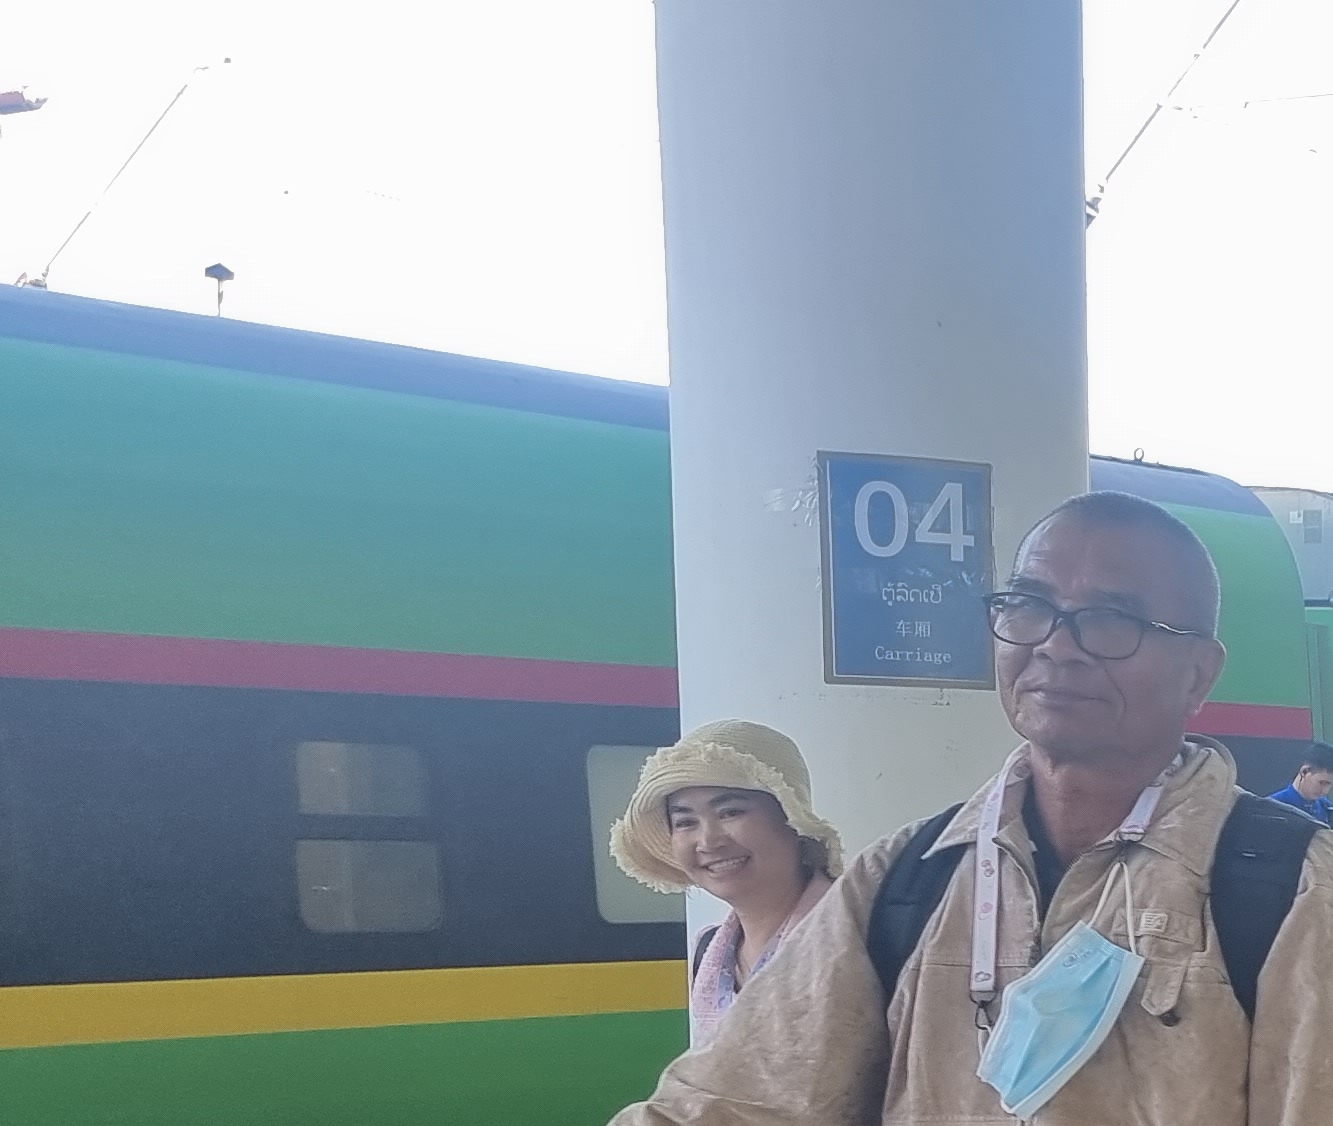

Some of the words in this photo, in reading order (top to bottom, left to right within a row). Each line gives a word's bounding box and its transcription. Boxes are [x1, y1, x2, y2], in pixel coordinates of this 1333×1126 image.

[854, 480, 975, 562] 04
[895, 619, 932, 638] 车厢
[874, 645, 952, 665] Carriage
